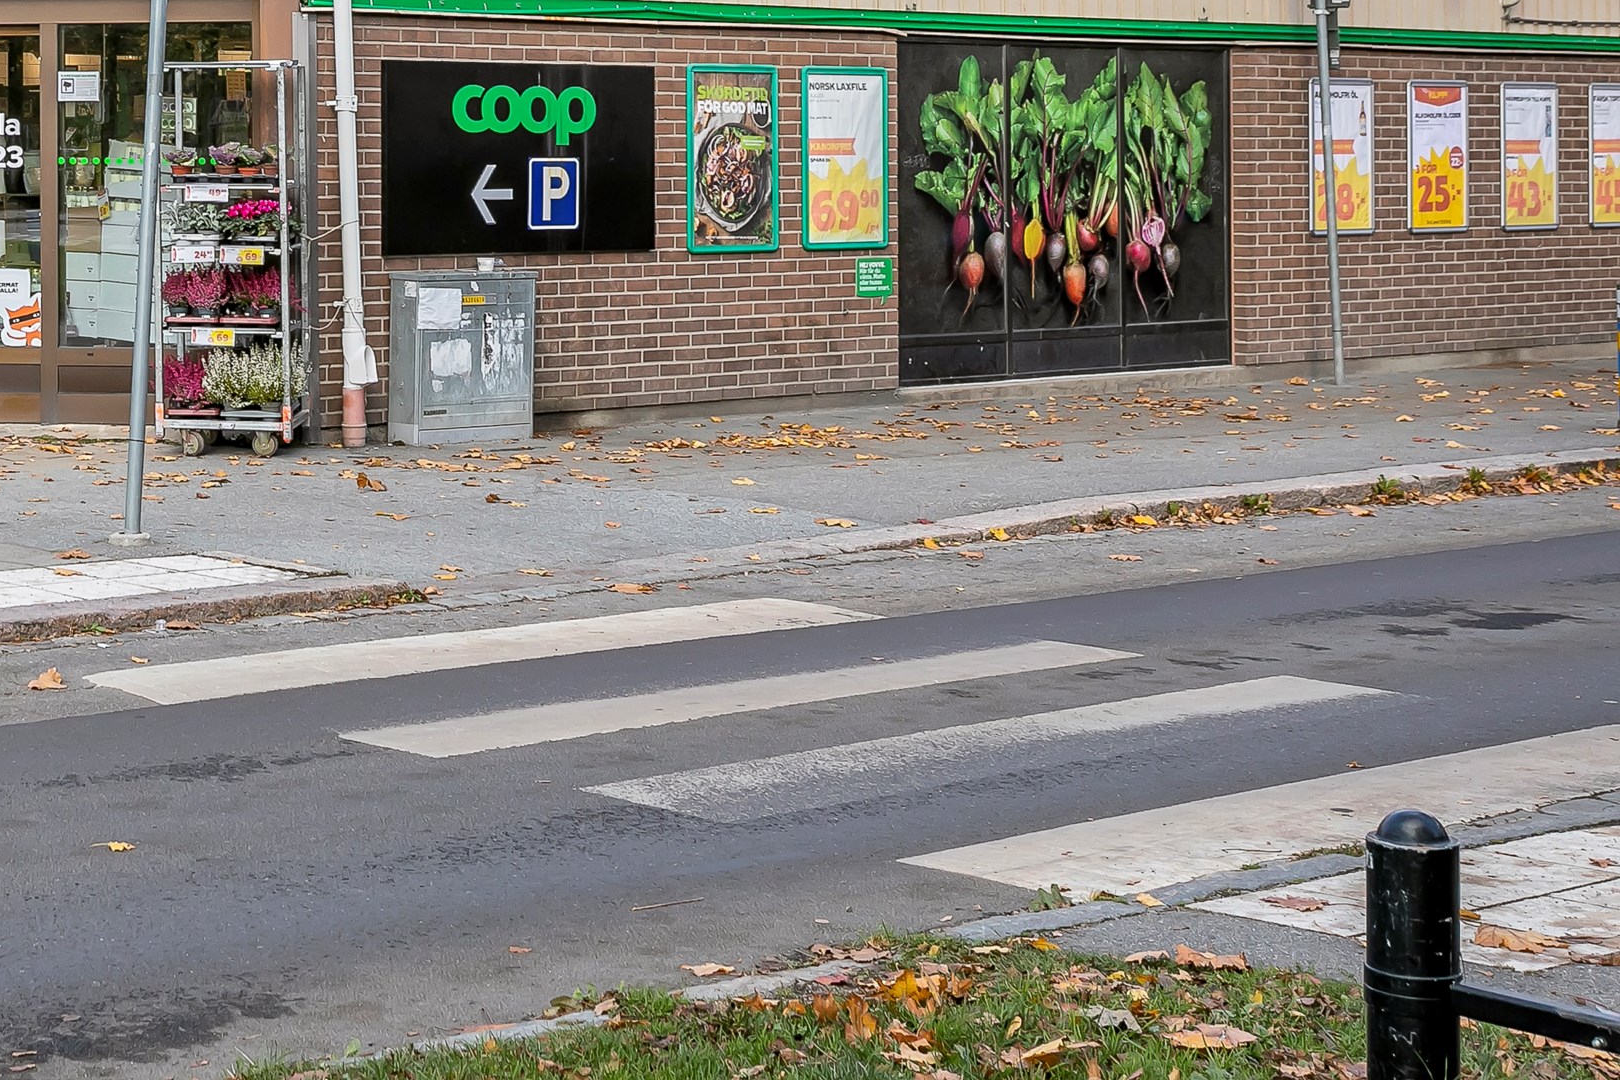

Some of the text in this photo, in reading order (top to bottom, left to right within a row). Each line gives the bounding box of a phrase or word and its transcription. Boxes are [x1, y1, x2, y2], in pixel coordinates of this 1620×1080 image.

[809, 82, 835, 91] NORSK
[452, 84, 597, 146] coop
[697, 100, 768, 115] FÖR GOD MAT
[542, 165, 571, 222] P
[811, 189, 860, 233] 69
[1417, 175, 1451, 213] 25
[1507, 181, 1543, 217] 43
